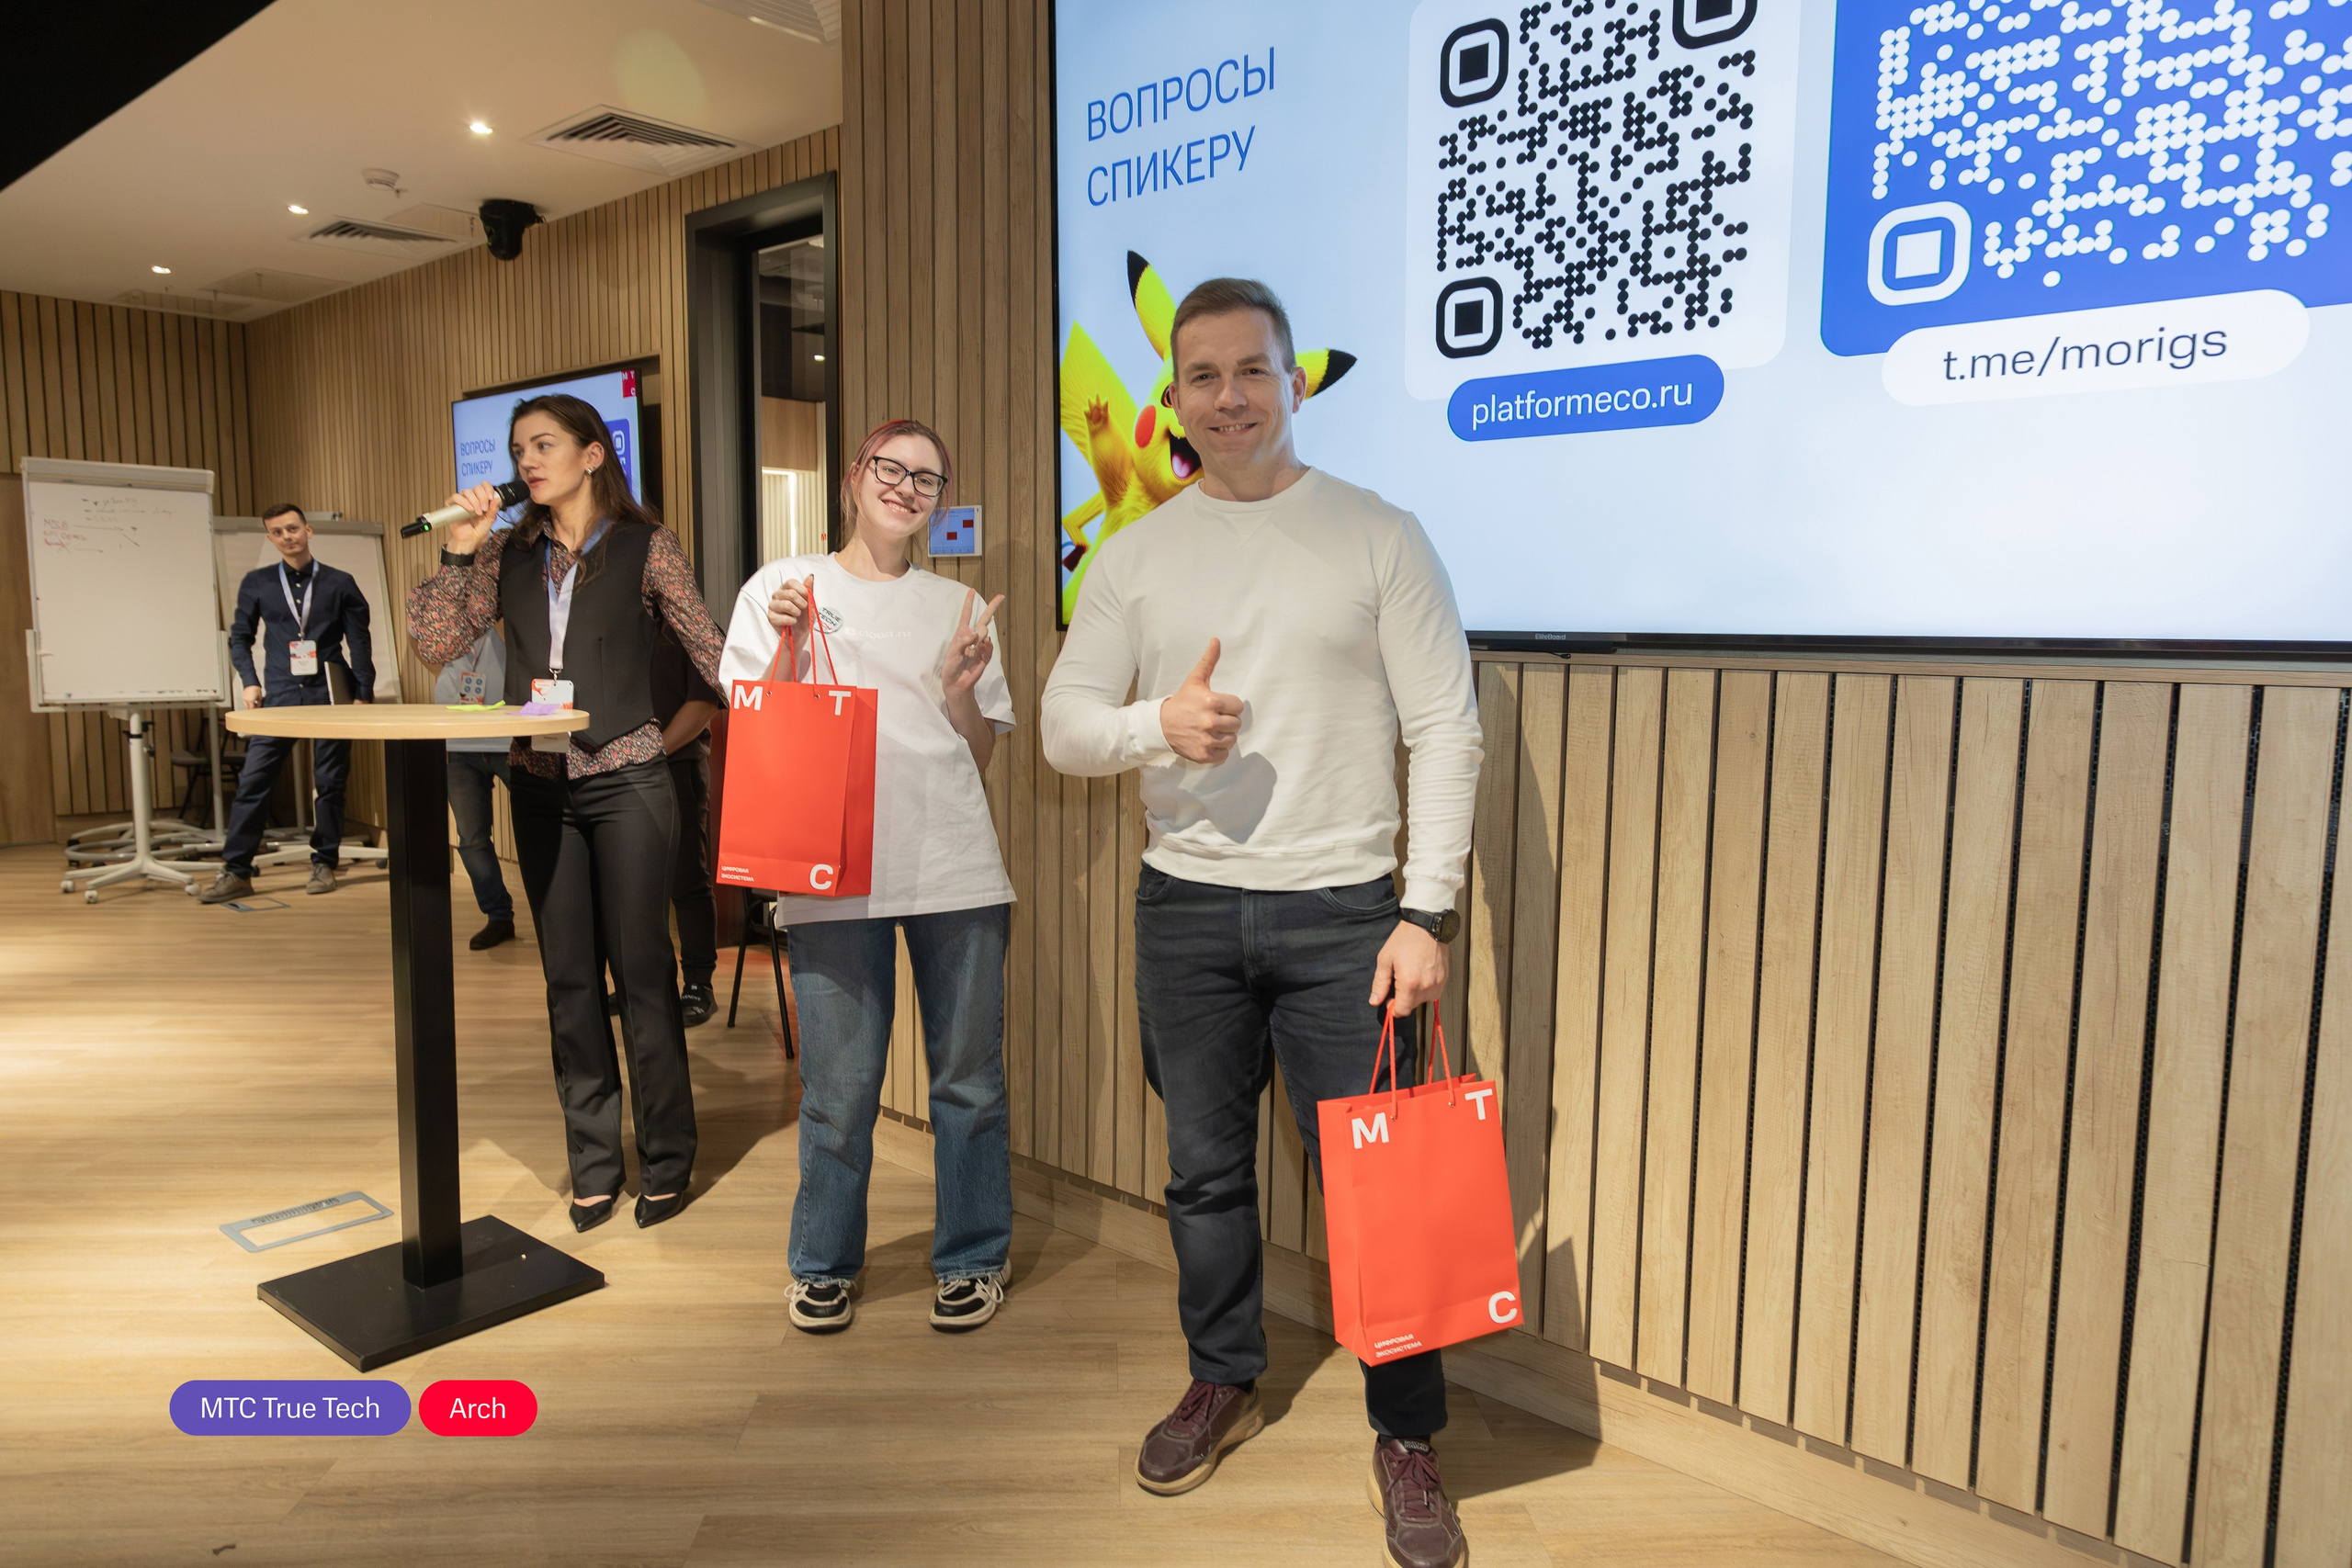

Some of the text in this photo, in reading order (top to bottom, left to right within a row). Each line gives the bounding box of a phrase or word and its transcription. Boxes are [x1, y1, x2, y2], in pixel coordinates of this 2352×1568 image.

[1088, 46, 1275, 142] ВОПРОСЫ
[1088, 125, 1256, 207] СПИКЕРУ
[1943, 326, 2227, 381] t.me/morigs
[1472, 382, 1693, 432] platformeco.ru
[460, 438, 495, 457] ВОПРОСЫ
[461, 459, 492, 477] СПИКЕРУ
[822, 606, 842, 623] TRUE
[733, 684, 852, 716] М Т
[1351, 1089, 1493, 1149] М Т
